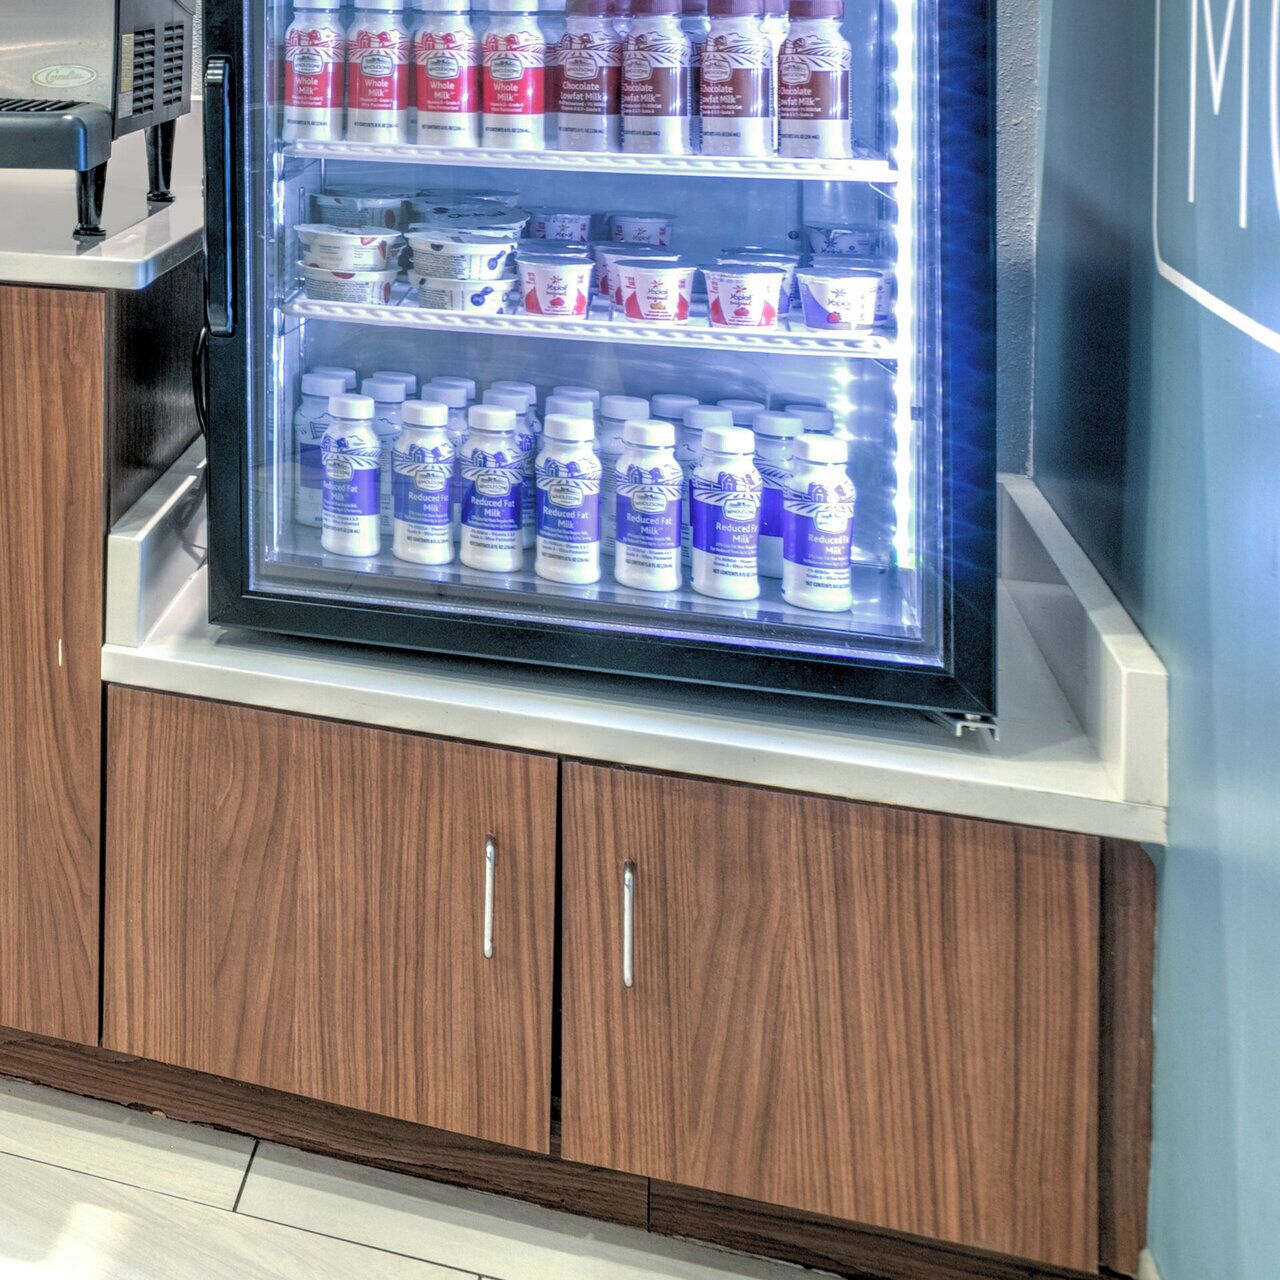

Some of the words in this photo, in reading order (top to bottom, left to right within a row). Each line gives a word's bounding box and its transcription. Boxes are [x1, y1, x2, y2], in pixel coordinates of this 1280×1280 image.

[296, 76, 319, 86] Whole
[364, 79, 389, 87] Whole
[429, 81, 455, 90] Whole
[562, 81, 600, 91] Chocolate
[493, 83, 519, 92] Whole
[346, 484, 358, 493] Fat
[409, 492, 440, 503] Reduced
[471, 496, 503, 507] Reduced
[504, 499, 515, 508] Fat
[543, 506, 576, 518] Reduced
[577, 510, 589, 519] Fat
[626, 513, 660, 524] Reduced
[661, 516, 672, 525] Fat
[716, 522, 750, 532] Reduced
[808, 534, 841, 544] Reduced
